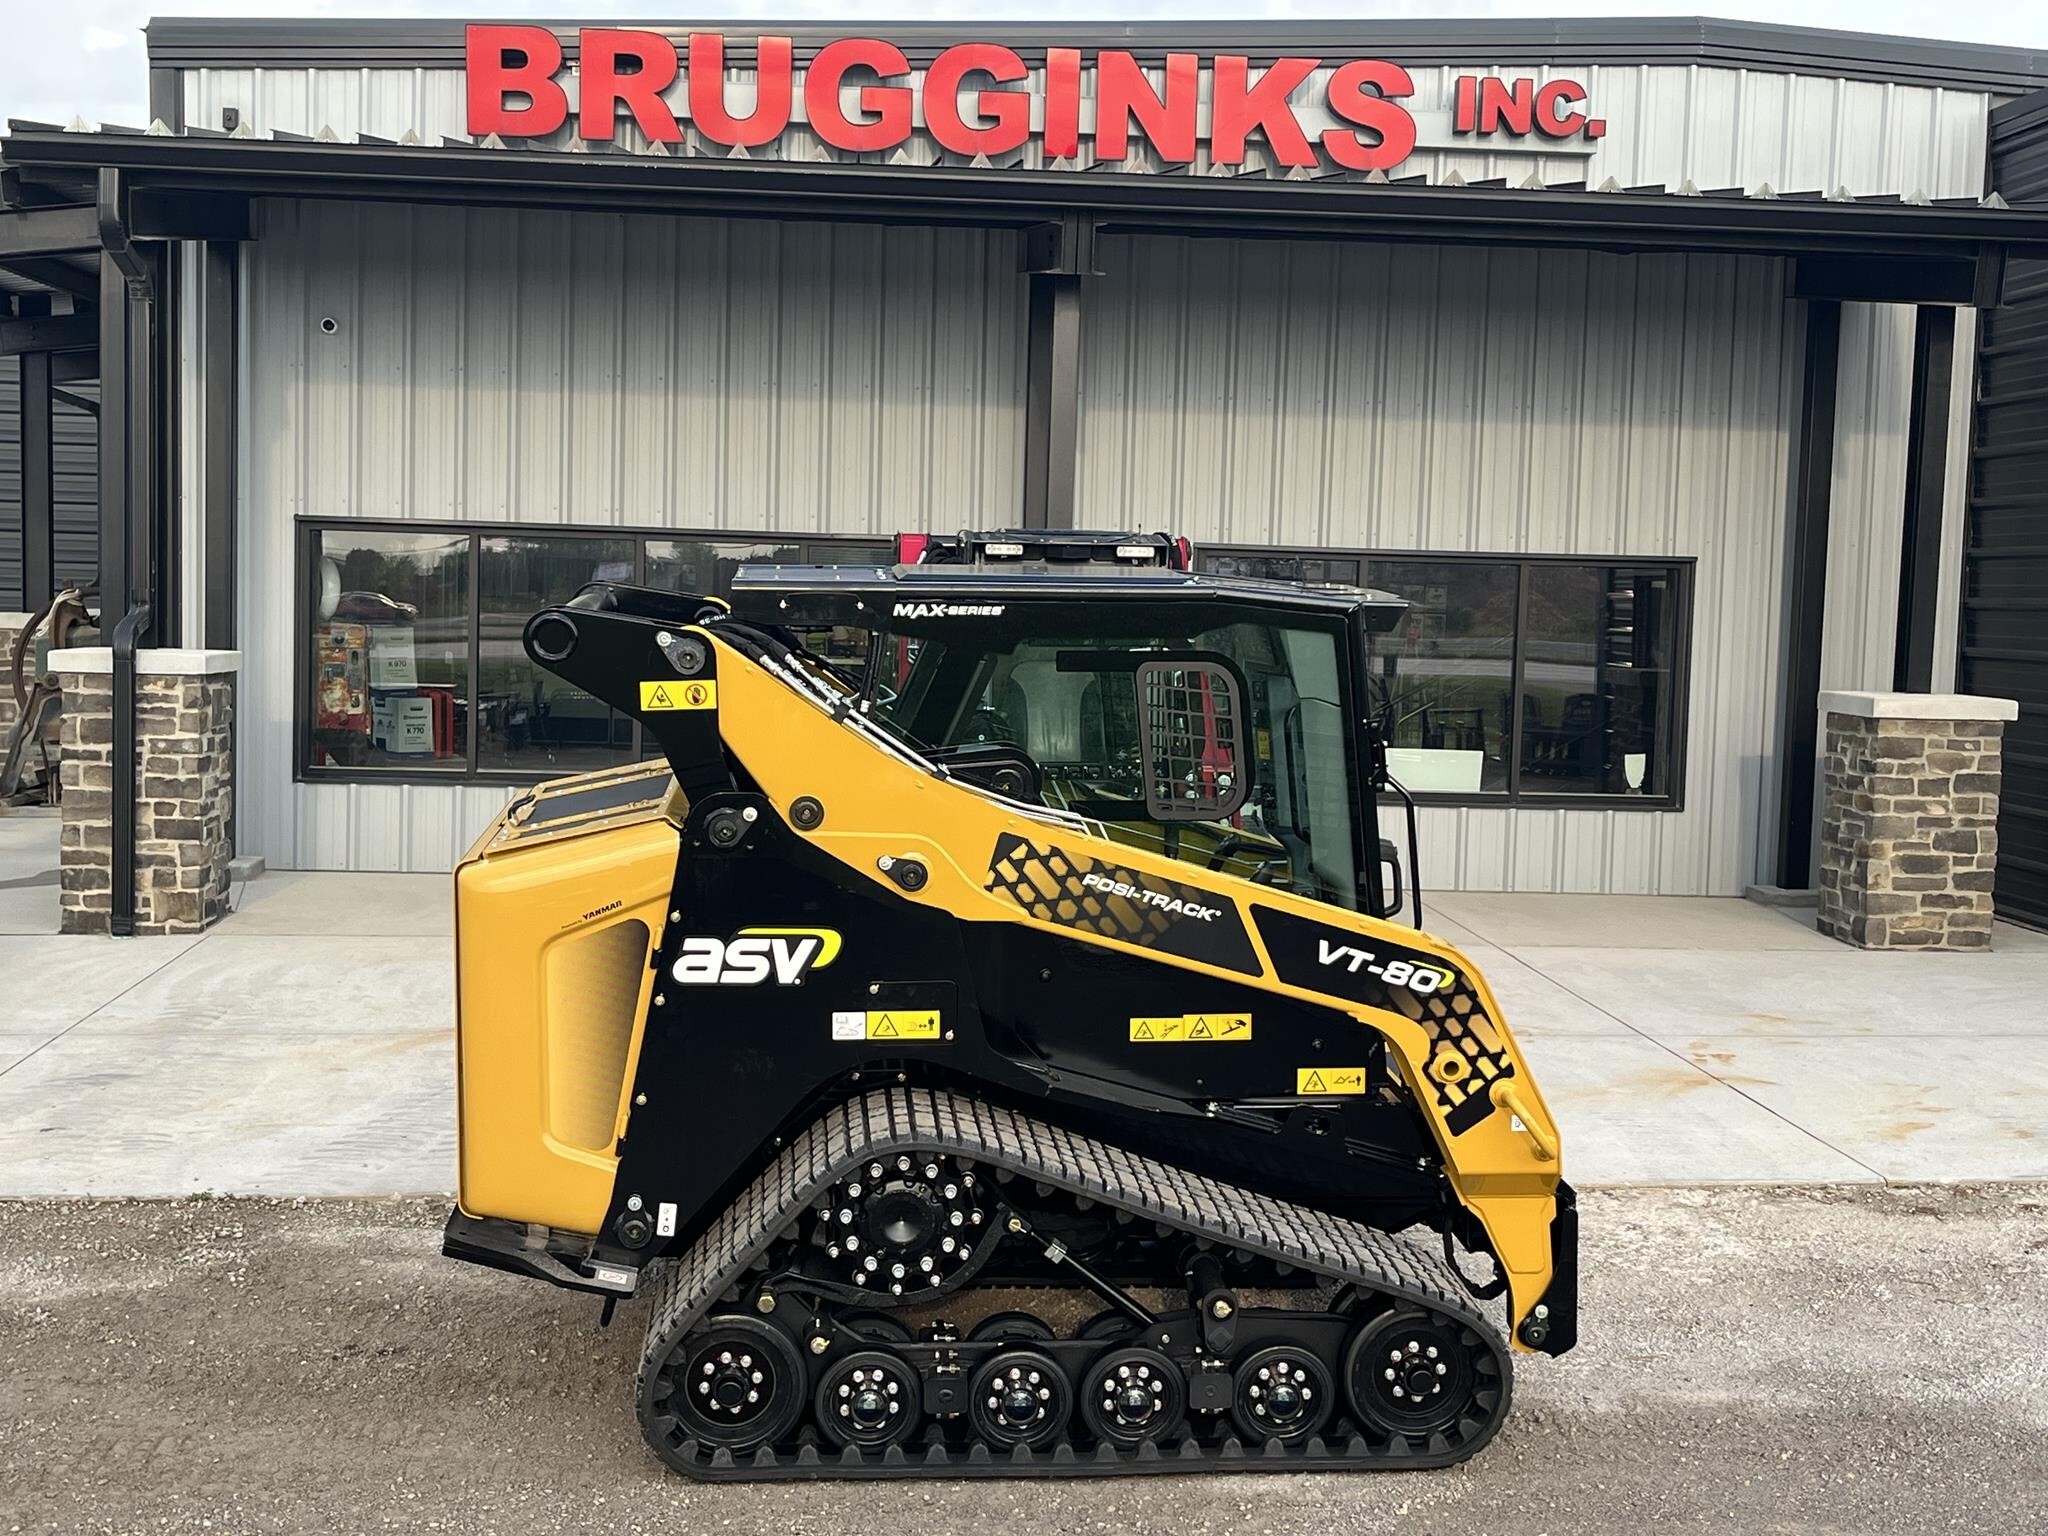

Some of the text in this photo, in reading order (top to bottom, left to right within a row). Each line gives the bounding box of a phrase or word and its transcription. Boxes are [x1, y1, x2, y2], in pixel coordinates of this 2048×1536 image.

[465, 23, 1607, 172] BRUGGINKS INC.
[892, 603, 1005, 620] MAX-SERIES
[582, 900, 622, 920] YANMAR
[1081, 873, 1223, 922] POSI-TRACK
[1318, 939, 1442, 994] VT-80
